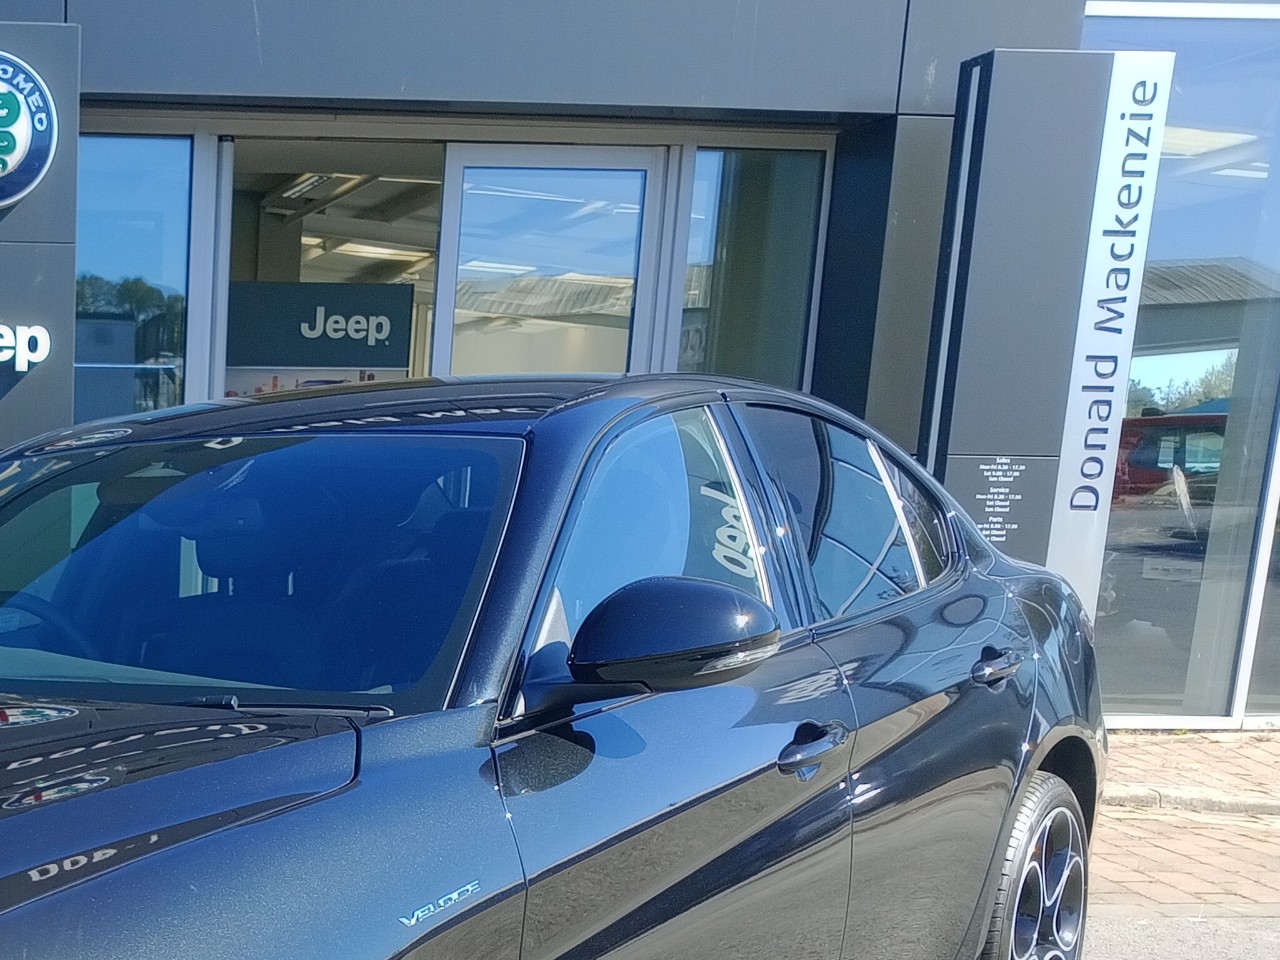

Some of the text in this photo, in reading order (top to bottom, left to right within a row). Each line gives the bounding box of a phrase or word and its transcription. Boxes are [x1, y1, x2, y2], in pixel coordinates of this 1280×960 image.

[1070, 79, 1158, 512] Donald Mackenzie
[299, 306, 391, 346] Jeep
[398, 878, 481, 928] VELOCE
